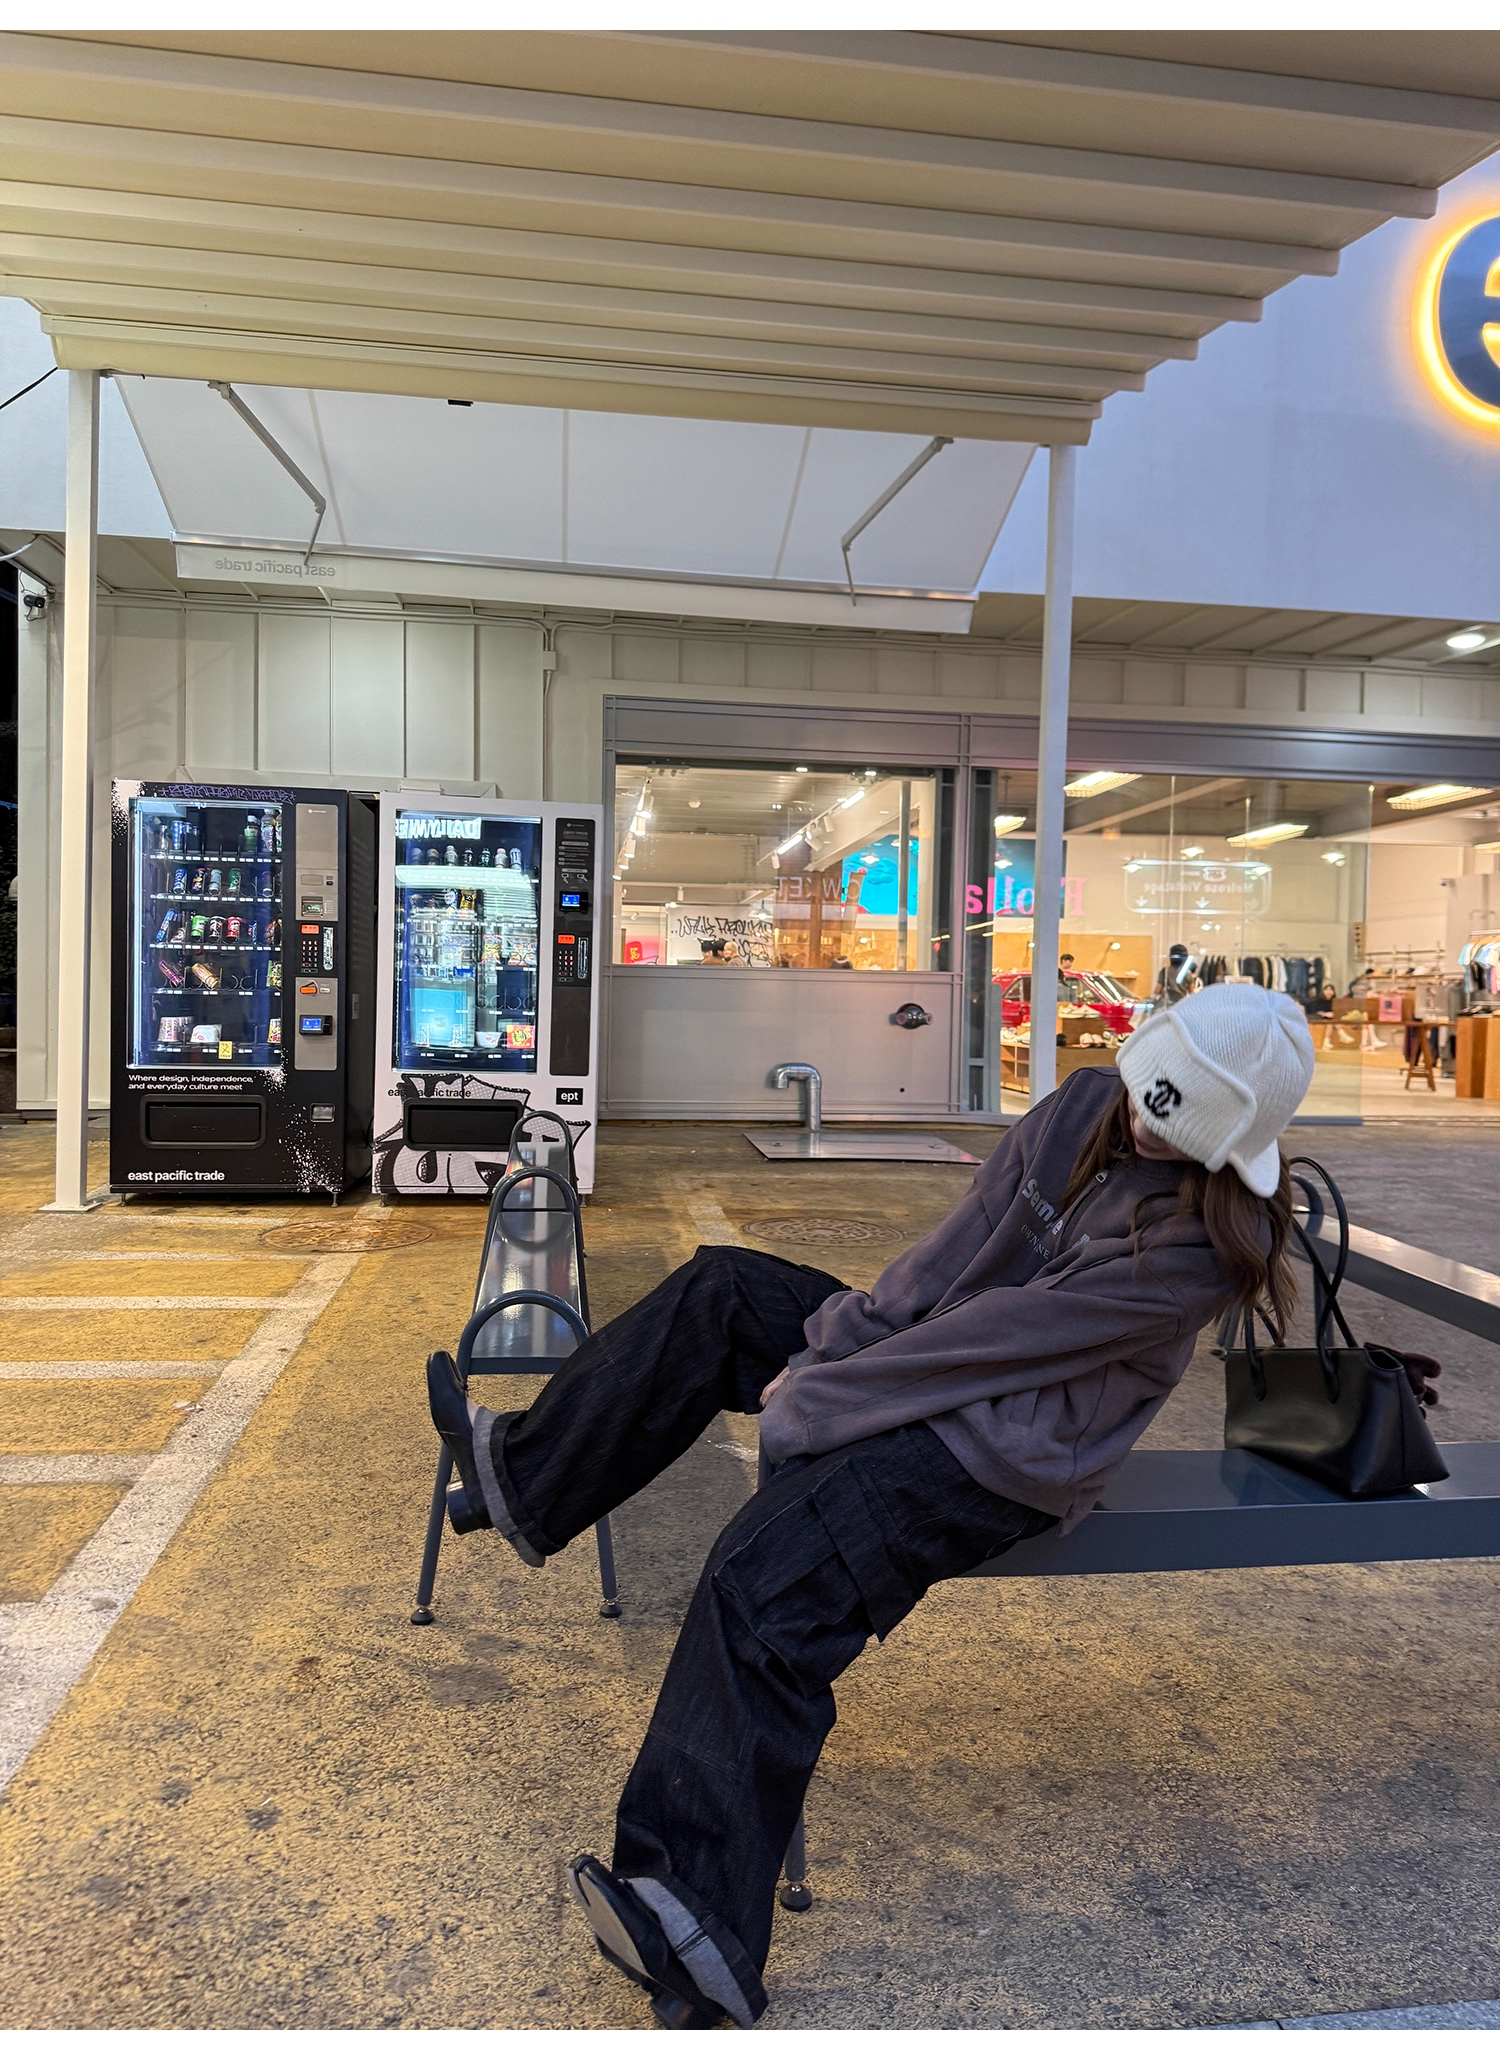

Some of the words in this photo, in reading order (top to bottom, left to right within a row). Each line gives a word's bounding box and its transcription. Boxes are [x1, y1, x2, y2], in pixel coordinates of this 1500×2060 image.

[128, 1074, 158, 1083] Where
[158, 1074, 190, 1083] design,
[191, 1074, 254, 1084] independence,
[146, 1083, 187, 1091] everyday
[188, 1083, 219, 1091] culture
[219, 1083, 243, 1091] meet
[560, 1091, 579, 1102] ept
[128, 1170, 153, 1181] east
[154, 1169, 194, 1183] pacific
[194, 1169, 226, 1181] trade
